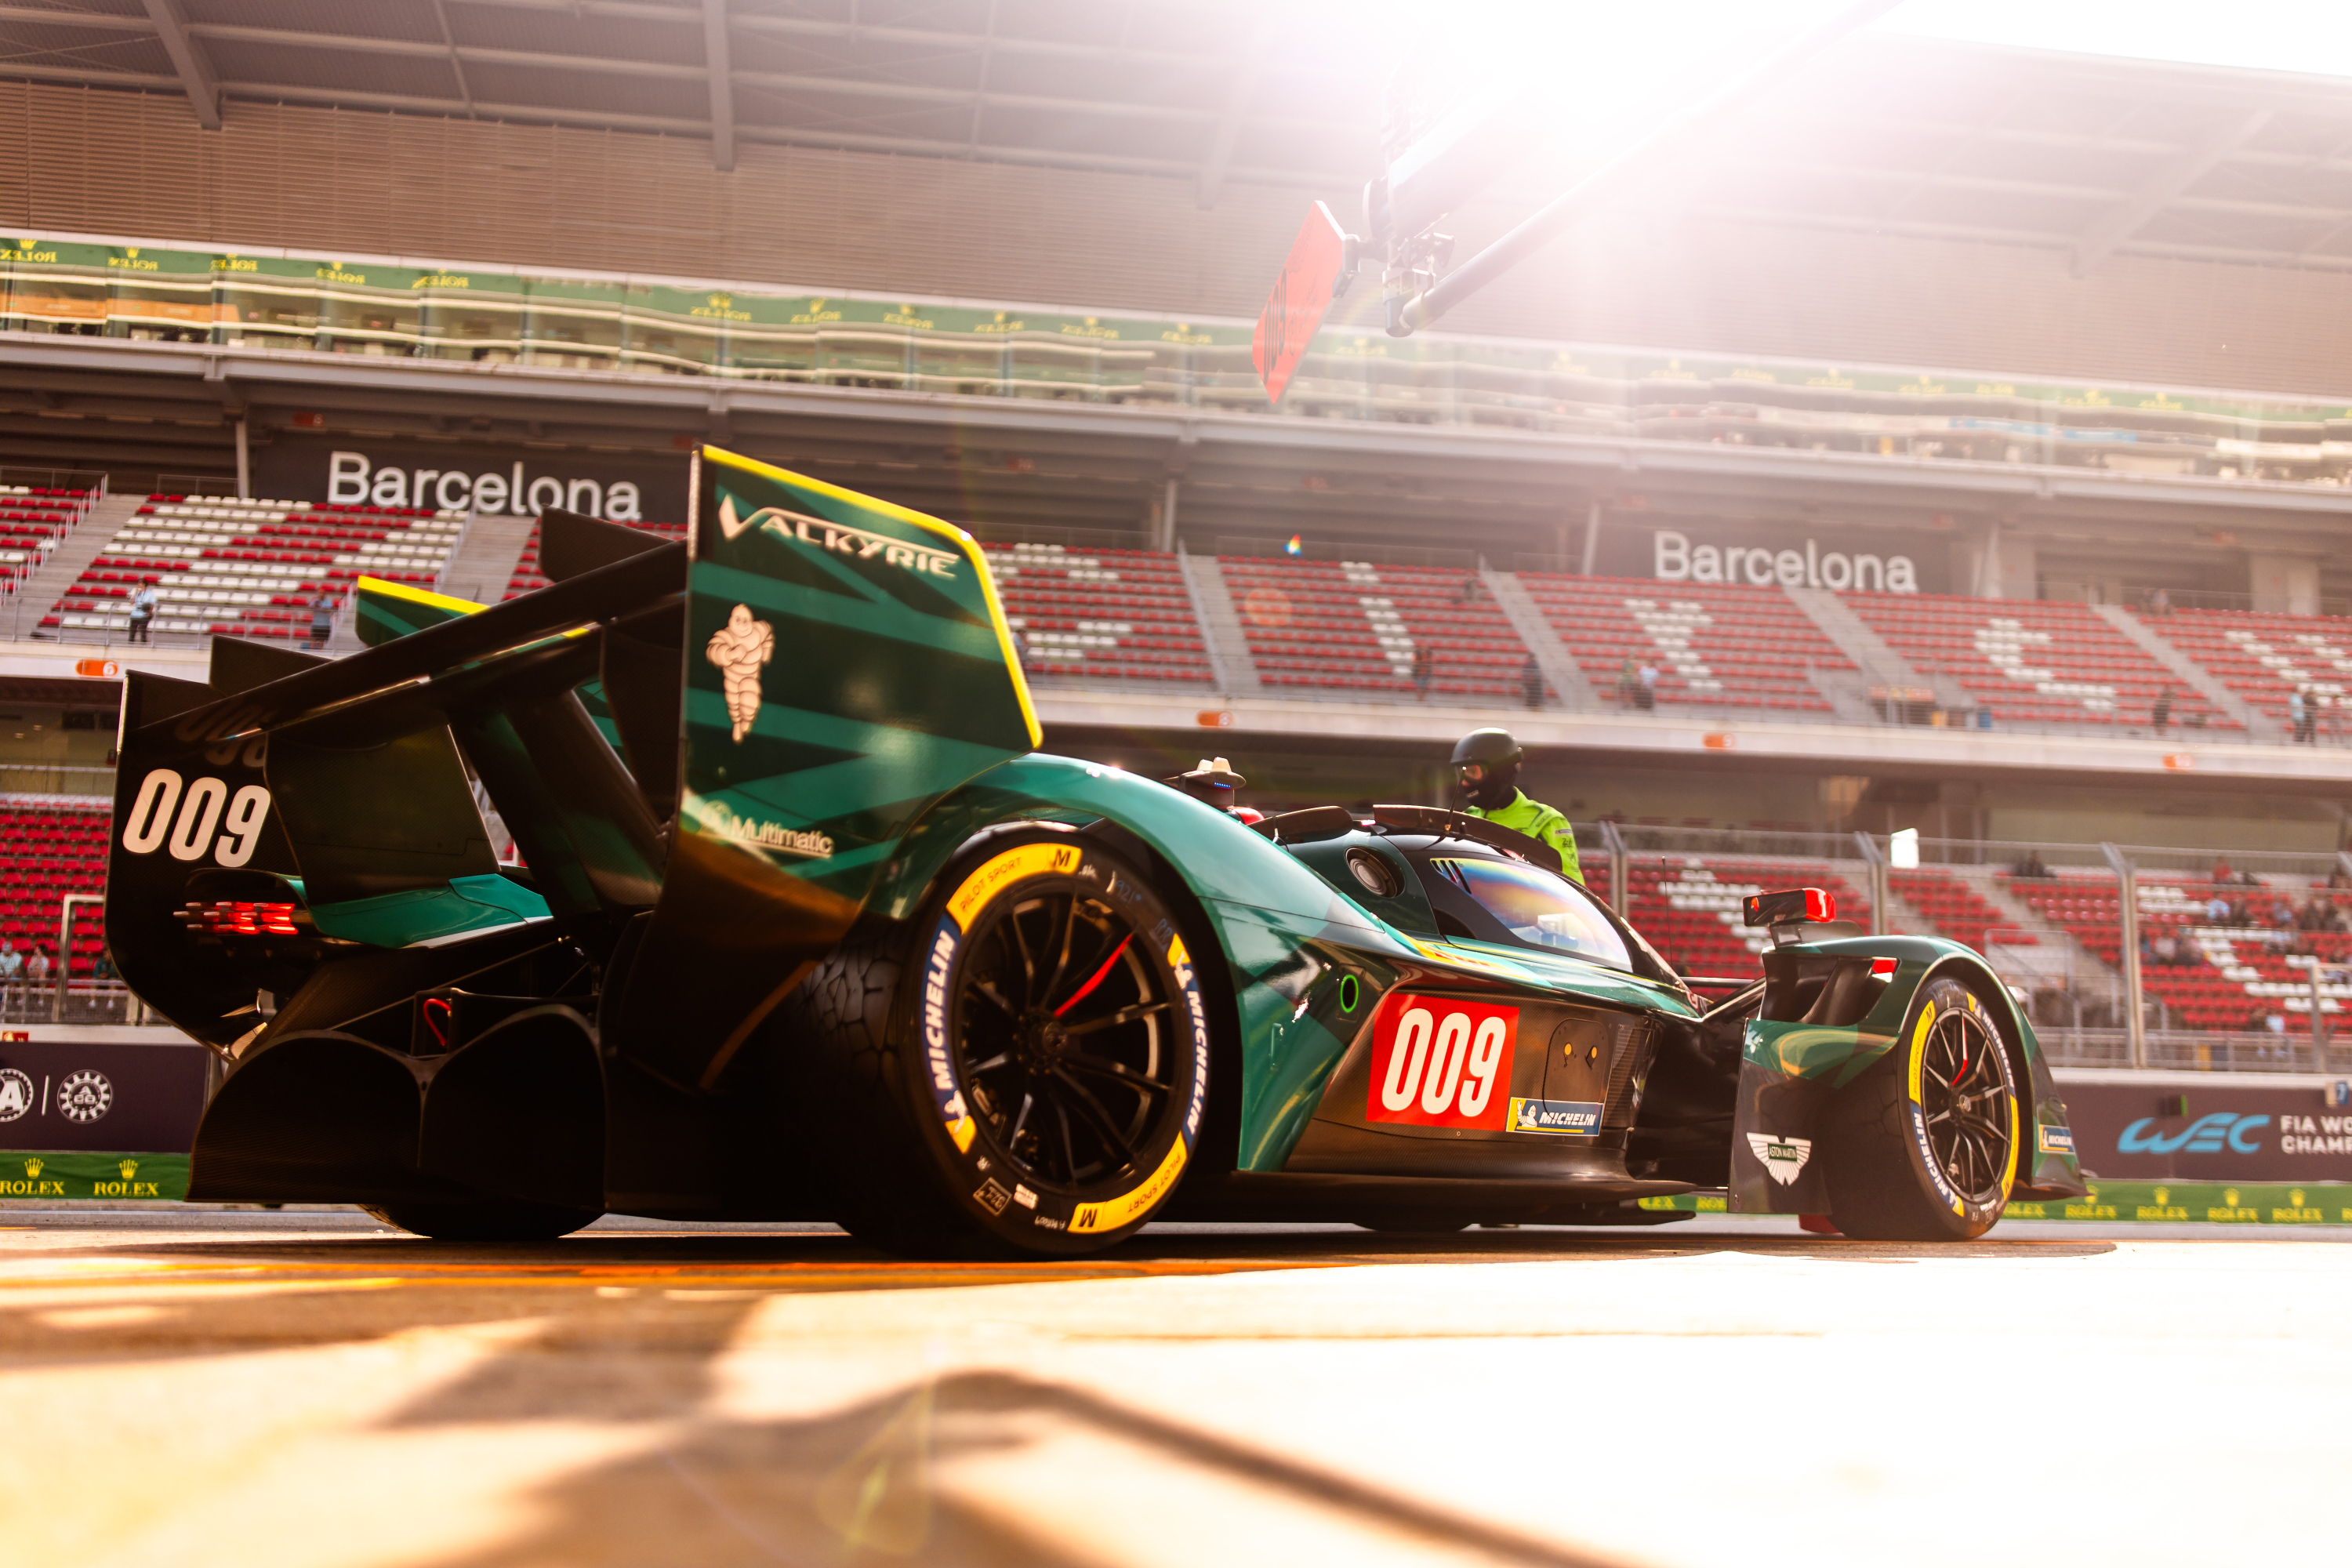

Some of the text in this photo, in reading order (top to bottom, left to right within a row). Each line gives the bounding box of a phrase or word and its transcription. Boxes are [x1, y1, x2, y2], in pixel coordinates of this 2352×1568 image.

[328, 450, 641, 522] Barcelona
[719, 494, 960, 579] VALKYRIE
[1654, 530, 1919, 593] Barcelona
[122, 768, 271, 867] 009
[730, 815, 835, 854] Multimatic
[1054, 848, 1072, 867] M
[960, 857, 1022, 913] PILOT SPORT
[925, 929, 957, 1091] MICHELIN
[1187, 990, 1208, 1135] MICHELIN
[1381, 1007, 1507, 1117] 009
[1982, 1011, 2015, 1089] MICHELIN
[1539, 1112, 1597, 1127] MICHELIN
[2118, 1112, 2271, 1155] WEC
[2281, 1115, 2317, 1134] FIA
[1769, 1145, 1797, 1159] ASTON MARTIN
[1914, 1112, 1950, 1197] MICHELIN
[0, 1180, 65, 1196] ROLEX
[93, 1181, 159, 1196] ROLEX
[1127, 1152, 1181, 1213] PILOT SPORT
[1078, 1208, 1098, 1228] M
[2064, 1203, 2117, 1219] ROLEX
[2136, 1205, 2190, 1221] ROLEX
[2207, 1207, 2259, 1223] ROLEX
[2272, 1207, 2324, 1223] ROLEX
